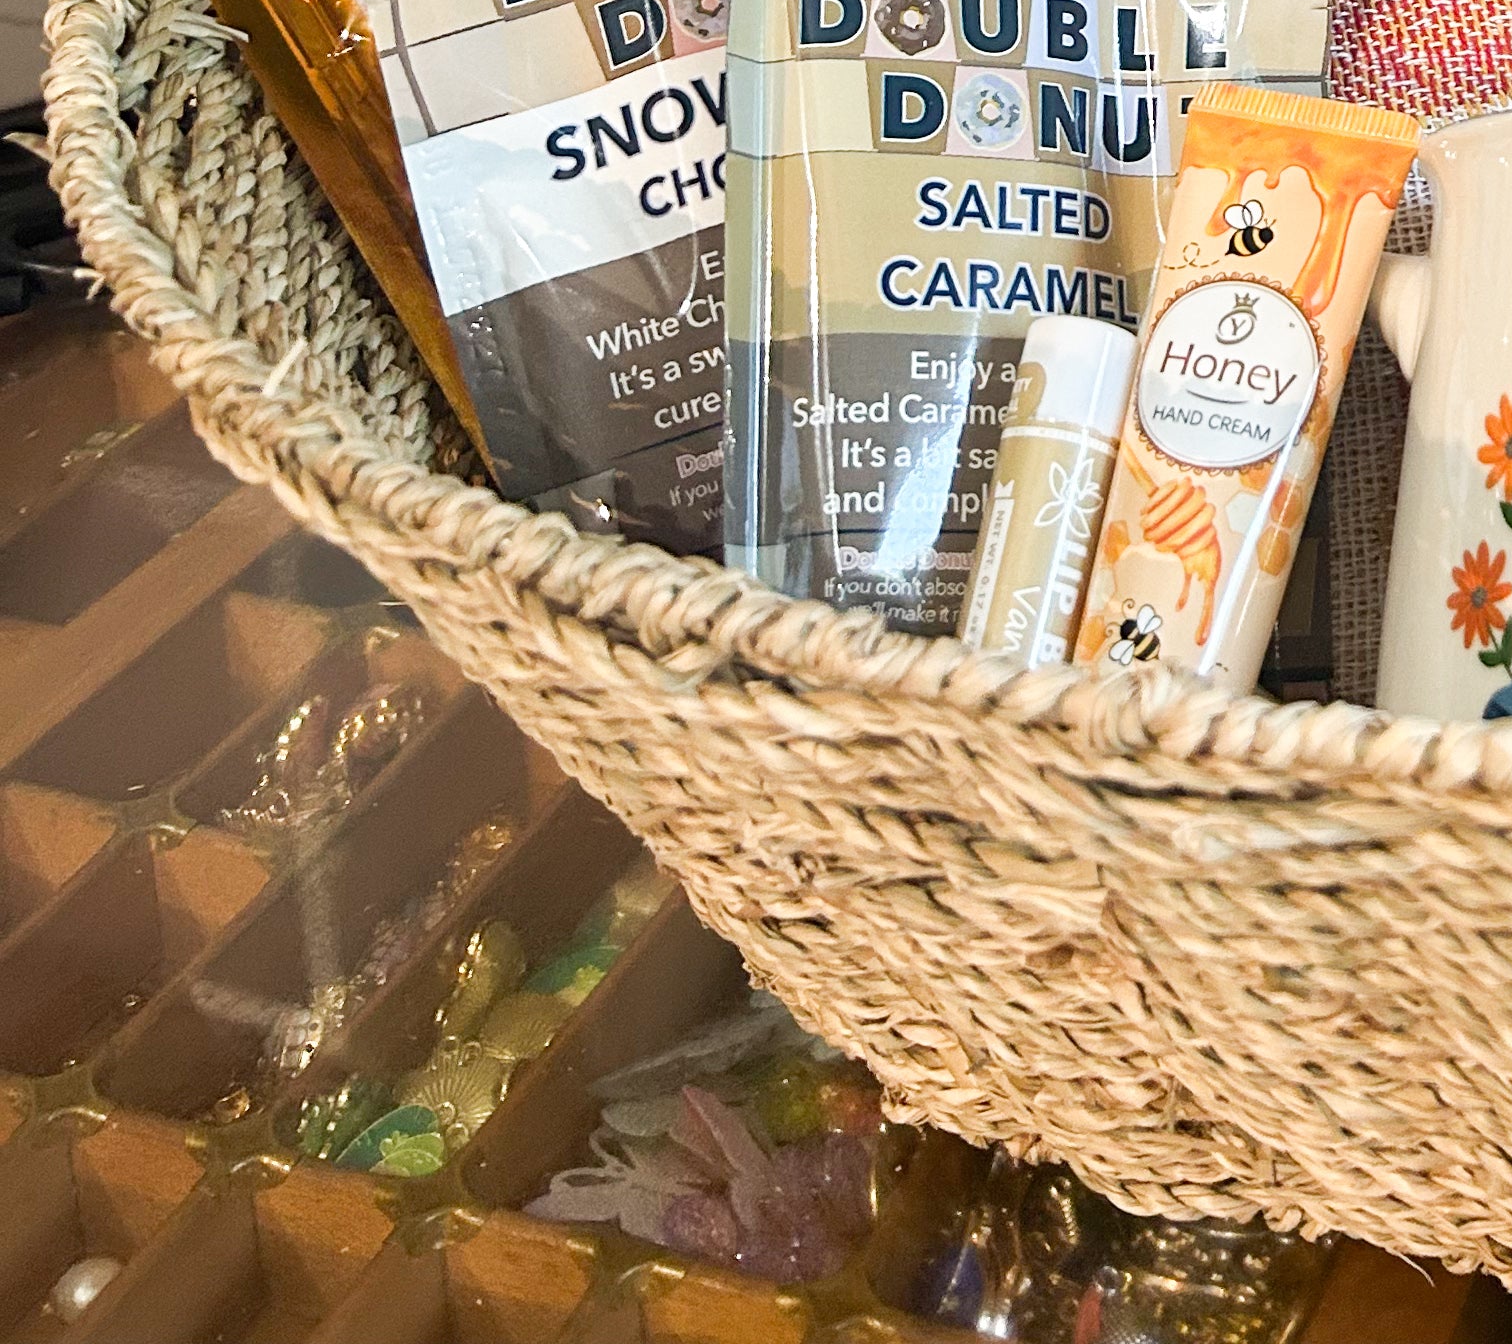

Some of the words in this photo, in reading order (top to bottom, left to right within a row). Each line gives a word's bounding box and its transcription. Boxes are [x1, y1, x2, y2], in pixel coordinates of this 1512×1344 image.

[881, 72, 1190, 166] DONU
[917, 178, 1112, 244] SALTED
[877, 257, 1141, 324] CARAMEL
[586, 314, 681, 362] White
[610, 364, 657, 400] It's
[664, 361, 682, 382] a
[911, 350, 993, 389] Enjoy
[1001, 362, 1016, 383] a
[1159, 339, 1298, 406] Honey
[654, 390, 723, 431] cure
[792, 391, 890, 427] Salted
[899, 393, 1010, 425] Carame
[1151, 404, 1205, 429] HAND
[1207, 413, 1273, 444] CREAM
[841, 437, 886, 468] It's
[895, 446, 911, 468] a
[685, 480, 719, 507] you
[823, 481, 885, 515] and
[993, 510, 1007, 538] NET
[838, 581, 871, 602] you
[875, 576, 922, 596] don't
[1052, 539, 1088, 615] LIP
[888, 603, 936, 623] make
